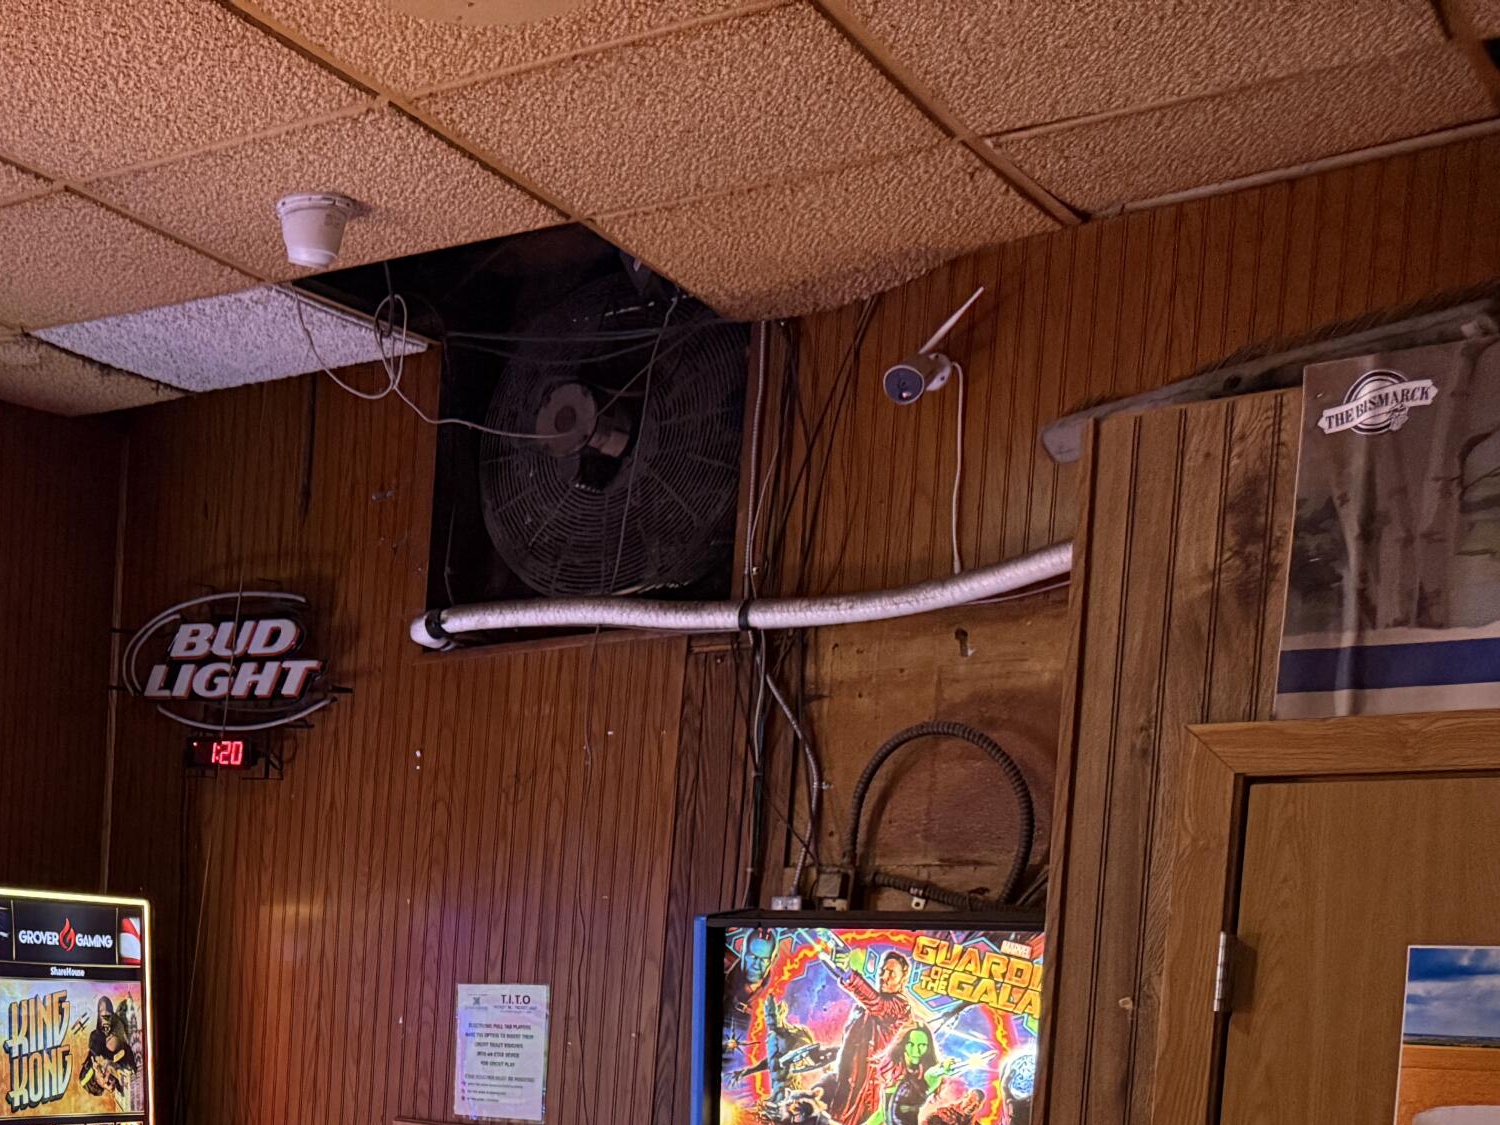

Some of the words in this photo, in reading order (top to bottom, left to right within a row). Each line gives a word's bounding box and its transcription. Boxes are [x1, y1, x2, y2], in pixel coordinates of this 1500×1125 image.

[1325, 410, 1355, 431] THE
[1355, 385, 1432, 419] BISMARCK
[169, 618, 301, 660] BUD
[143, 659, 322, 699] LIGHT
[211, 741, 244, 766] 1:20
[18, 930, 59, 945] GROVER
[75, 933, 113, 948] GAMING
[921, 976, 948, 995] THE
[931, 966, 953, 980] OF
[4, 990, 71, 1056] KING
[6, 1045, 73, 1113] KONG
